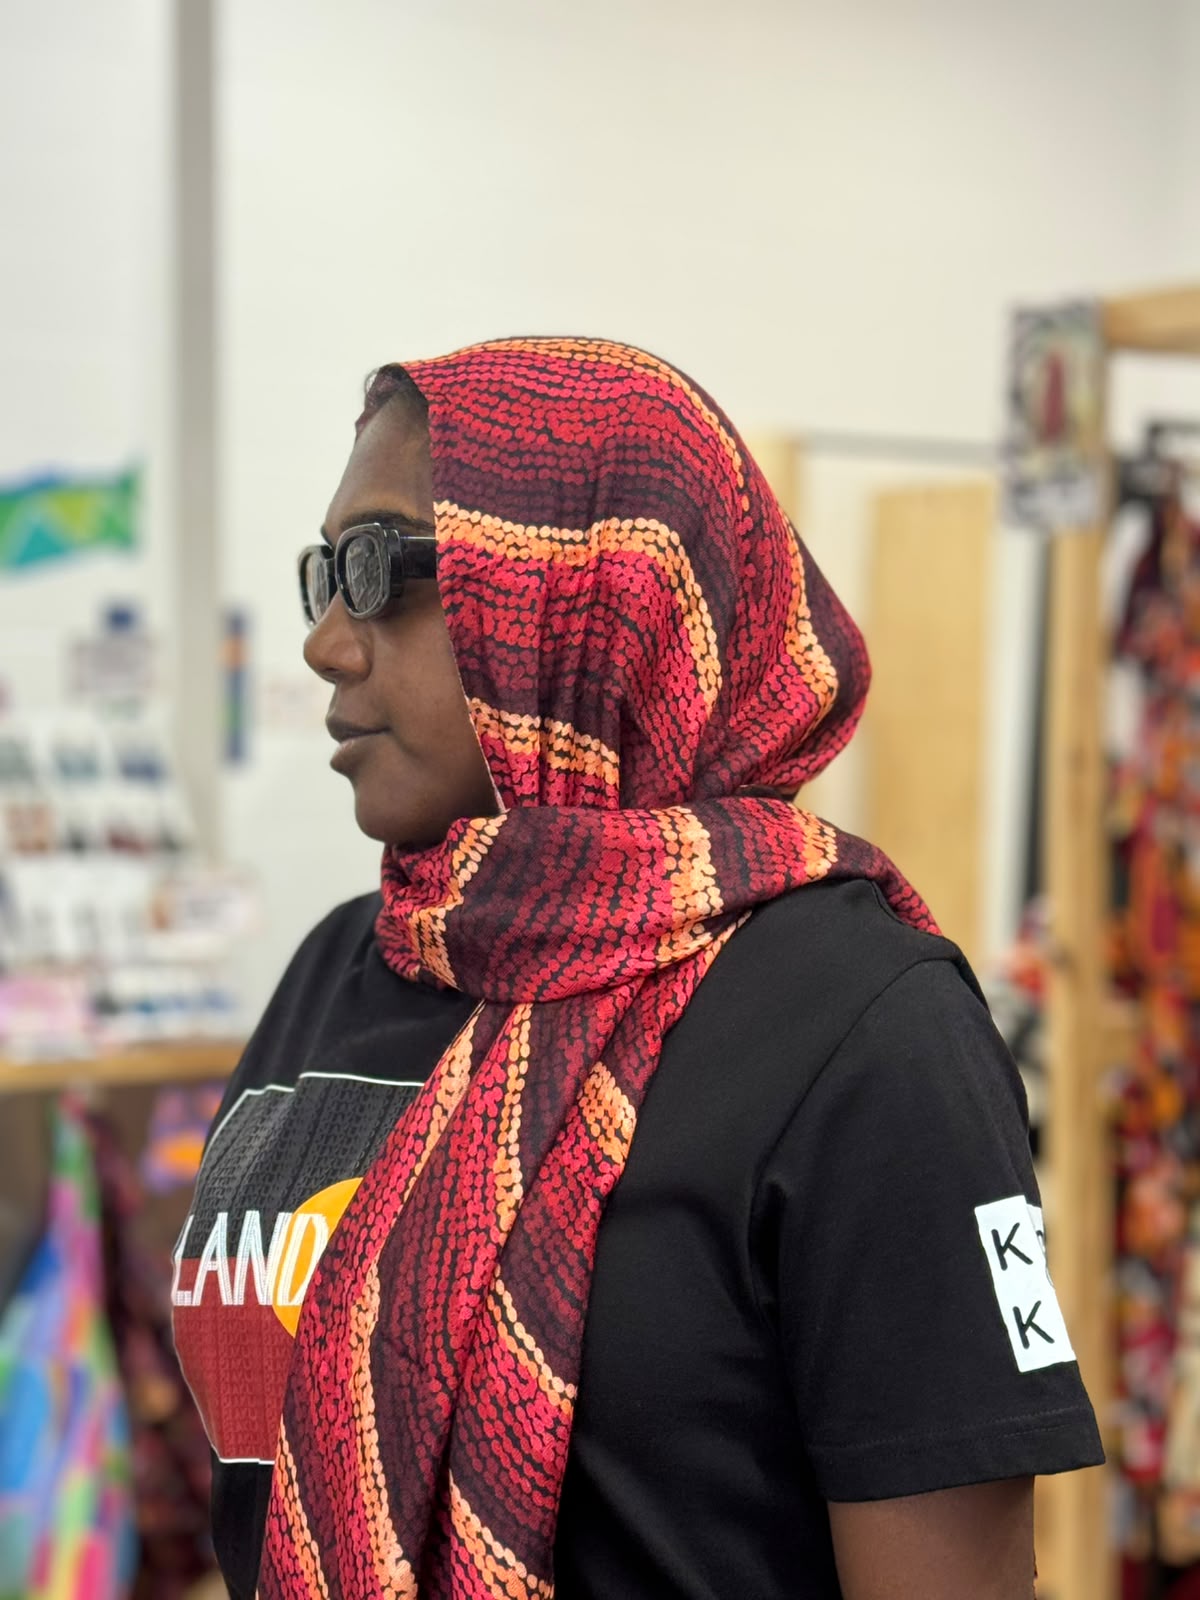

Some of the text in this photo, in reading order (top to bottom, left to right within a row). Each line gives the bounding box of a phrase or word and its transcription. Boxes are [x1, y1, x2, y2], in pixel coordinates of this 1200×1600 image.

[171, 1210, 329, 1306] LAND
[991, 1222, 1033, 1271] K
[1013, 1300, 1055, 1349] K
